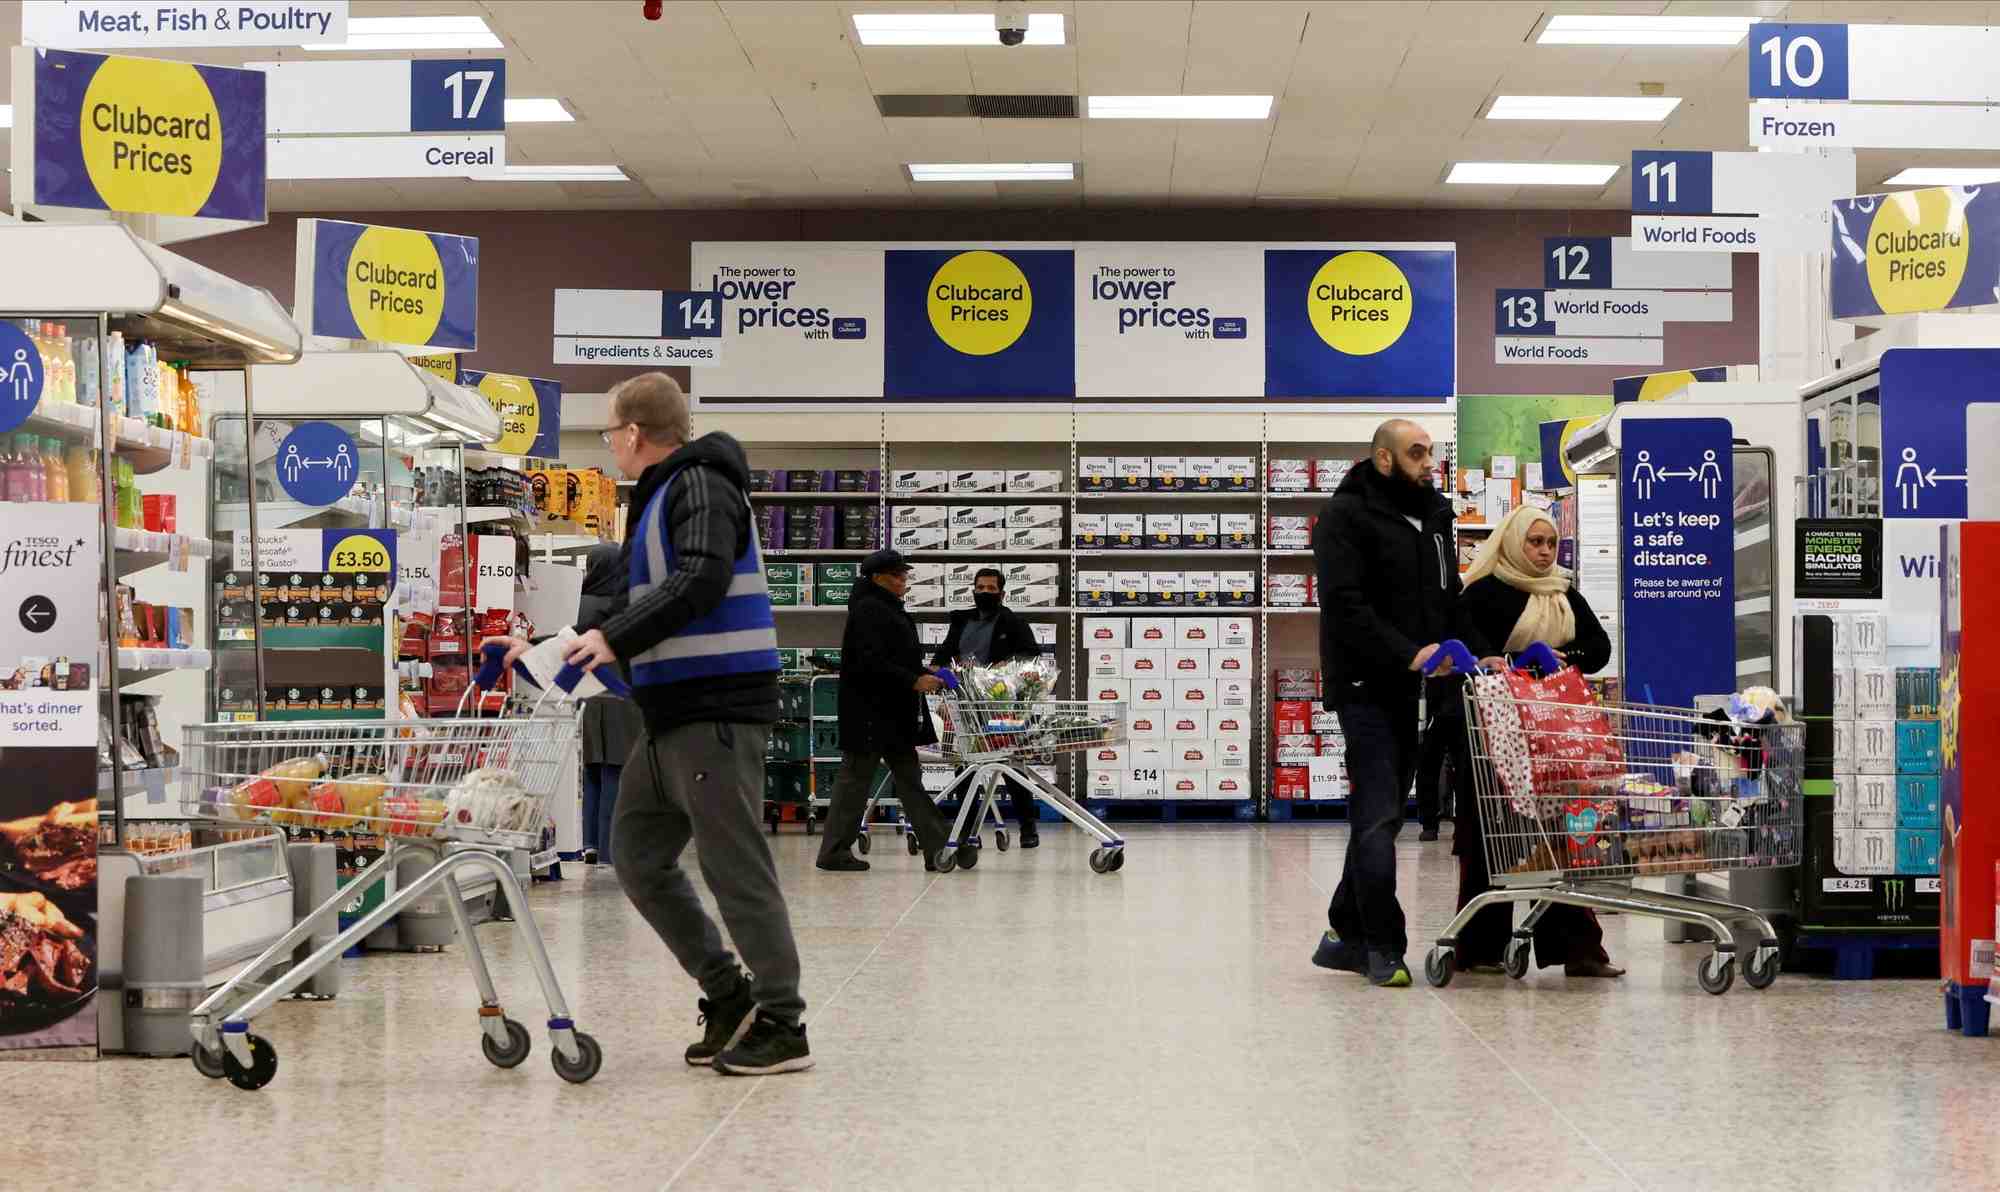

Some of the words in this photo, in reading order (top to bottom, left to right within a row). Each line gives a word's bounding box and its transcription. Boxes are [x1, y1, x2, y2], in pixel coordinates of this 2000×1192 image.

[79, 9, 149, 34] Meat,
[156, 7, 207, 31] Fish
[214, 10, 231, 30] &
[238, 7, 331, 34] Poultry
[1761, 36, 1824, 87] 10
[443, 71, 494, 119] 17
[92, 103, 211, 141] Clubcard
[1762, 116, 1835, 137] Frozen
[113, 141, 192, 175] Prices
[425, 147, 494, 166] Cereal
[1641, 161, 1677, 202] 11
[1643, 227, 1697, 243] World
[1702, 227, 1756, 244] Foods
[1875, 230, 1961, 255] Clubcard
[1552, 246, 1590, 280] 12
[1889, 259, 1946, 282] Prices
[355, 261, 437, 290] Clubcard
[720, 266, 743, 277] The
[744, 268, 781, 279] power
[783, 267, 796, 277] to
[1100, 266, 1122, 277] The
[1123, 268, 1161, 279] power
[1163, 267, 1175, 277] to
[713, 275, 796, 300] lower
[936, 285, 1023, 301] Clubcard
[1092, 275, 1176, 300] lower
[1316, 285, 1403, 301] Clubcard
[369, 290, 424, 315] Prices
[1554, 301, 1599, 315] World
[1603, 301, 1649, 315] Foods
[678, 299, 715, 330] 14
[738, 301, 830, 334] prices
[951, 306, 1009, 322] Prices
[1119, 301, 1210, 334] prices
[1331, 306, 1389, 322] Prices
[1502, 296, 1538, 328] 13
[804, 329, 829, 339] with
[1184, 329, 1210, 339] with
[574, 344, 650, 361] Ingredients
[653, 345, 663, 358] &
[666, 345, 714, 359] Sauces
[1504, 345, 1544, 359] World
[1548, 345, 1589, 359] Foods
[409, 355, 452, 370] lubcard
[489, 397, 534, 416] ubcard
[895, 480, 920, 488] CARLING
[952, 480, 977, 488] CARLING
[1633, 511, 1674, 527] Let's
[1678, 510, 1720, 529] keep
[1633, 534, 1643, 546] a
[1648, 532, 1684, 546] safe
[1805, 545, 1861, 553] ENERGY
[0, 540, 75, 575] finest
[336, 552, 384, 567] £3.50
[1633, 551, 1712, 567] distance.
[1805, 554, 1862, 562] RACING
[479, 566, 513, 577] £1.50
[1633, 578, 1664, 588] Please
[1666, 578, 1678, 588] be
[1680, 580, 1710, 588] aware
[1712, 578, 1723, 587] of
[1633, 589, 1665, 598] others
[1667, 589, 1701, 598] around
[1703, 591, 1721, 600] you
[0, 702, 34, 714] hat's
[38, 702, 83, 714] dinner
[12, 720, 63, 732] sorted.
[1133, 769, 1157, 782] £14
[1836, 880, 1867, 889] £4.25
